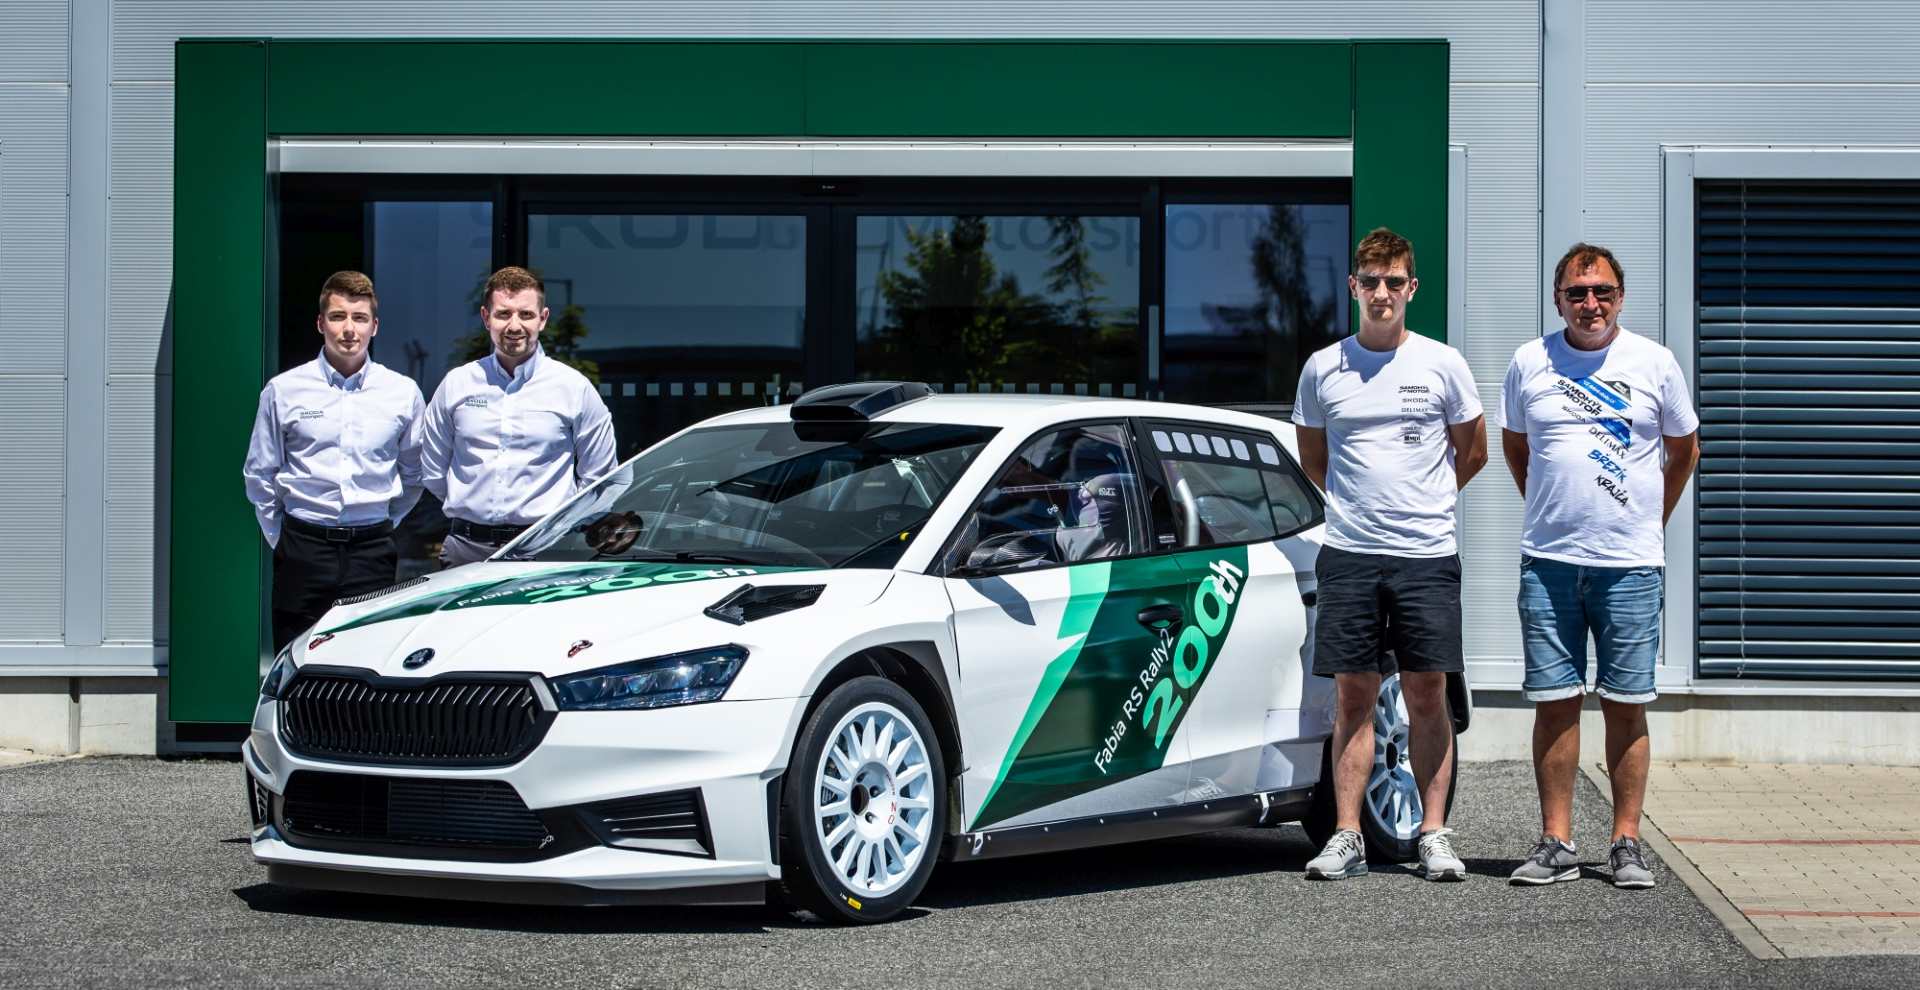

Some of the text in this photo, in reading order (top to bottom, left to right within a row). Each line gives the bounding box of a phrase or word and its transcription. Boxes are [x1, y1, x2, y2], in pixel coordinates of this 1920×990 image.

[1557, 380, 1602, 413] SAMOHYL
[1563, 390, 1600, 416] MOTOR
[1588, 426, 1626, 460] DELIMAX
[457, 590, 514, 607] Fabia
[524, 566, 758, 604] 200th
[1142, 559, 1243, 749] 200th
[1094, 628, 1174, 775] Fabia RS Rally2
